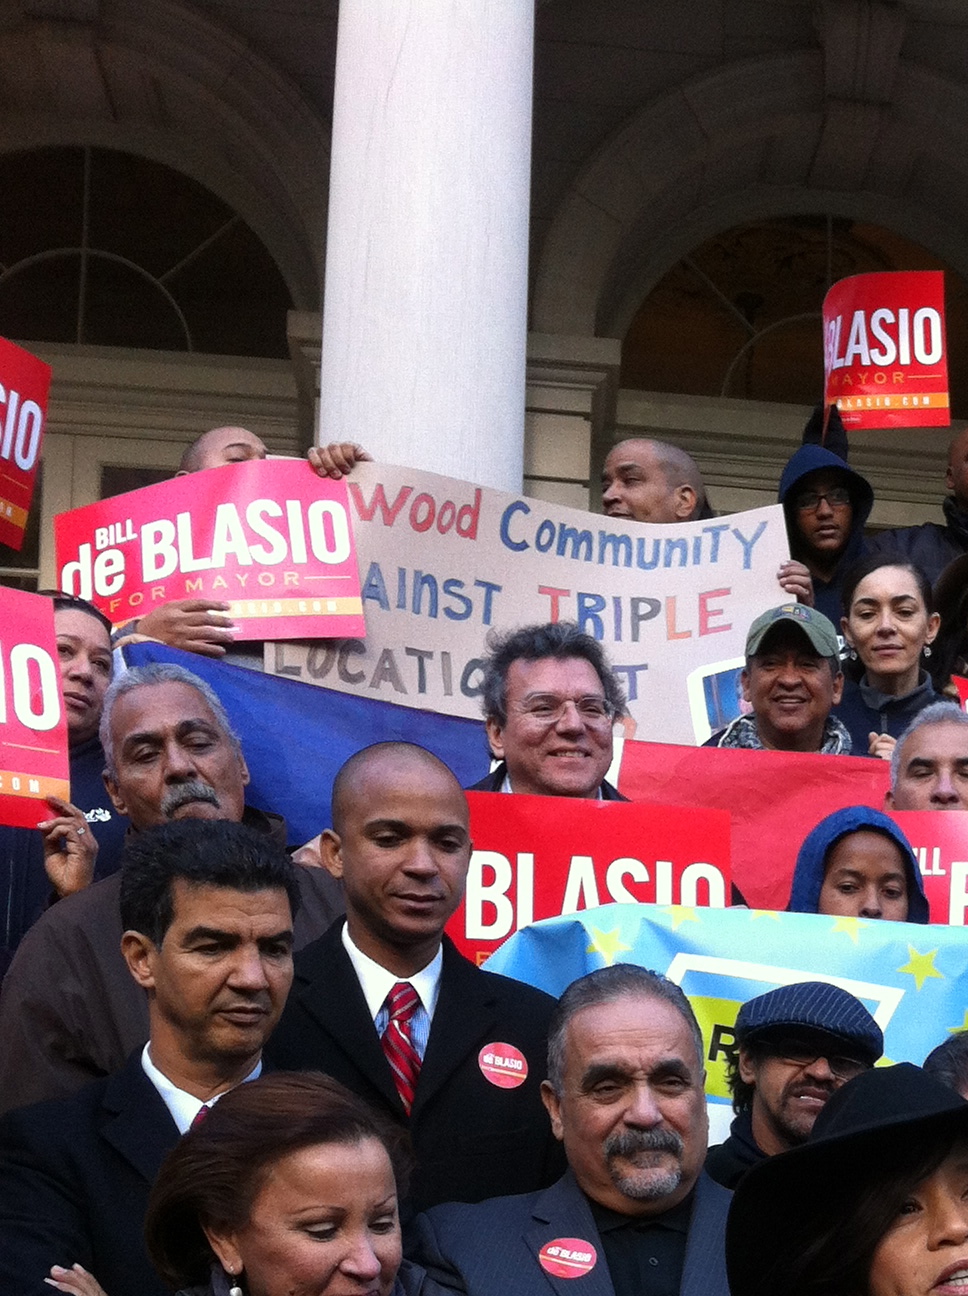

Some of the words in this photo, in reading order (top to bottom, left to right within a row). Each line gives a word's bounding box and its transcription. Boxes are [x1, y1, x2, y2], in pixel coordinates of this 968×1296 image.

[61, 542, 126, 601] de
[140, 498, 351, 584] BLASIO
[95, 518, 138, 550] BILL
[108, 586, 166, 614] FOR
[185, 571, 300, 594] MAYOR
[274, 637, 492, 698] LOCATIO
